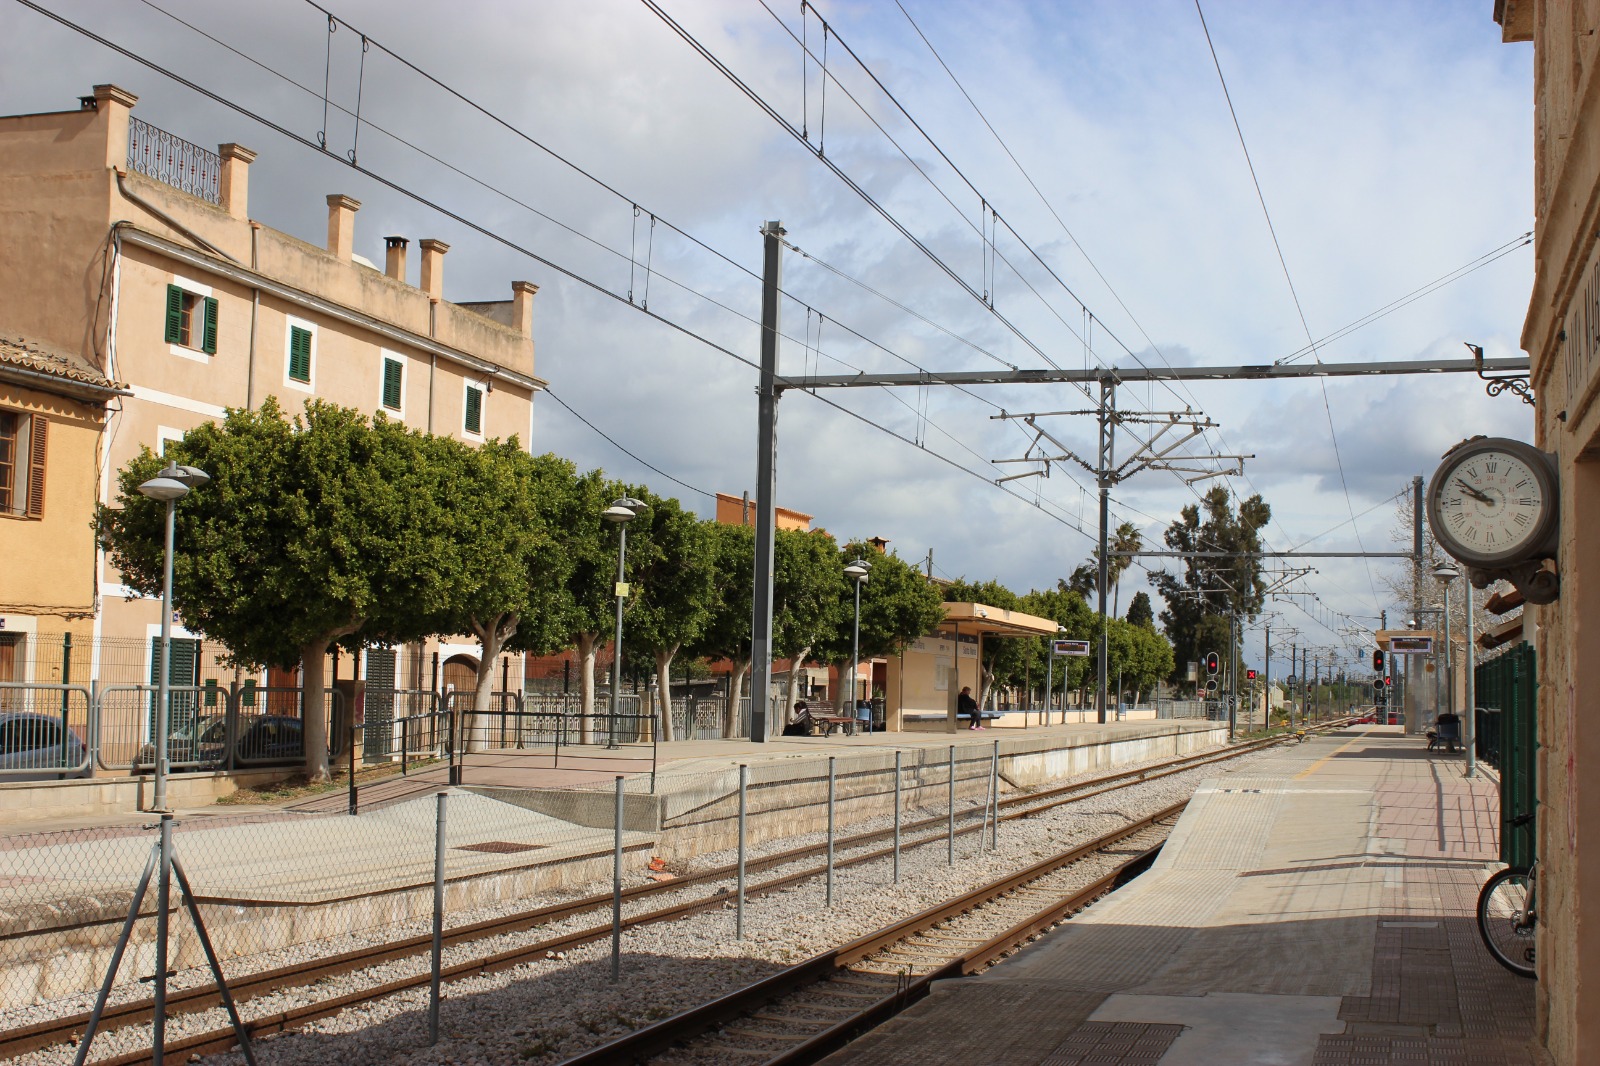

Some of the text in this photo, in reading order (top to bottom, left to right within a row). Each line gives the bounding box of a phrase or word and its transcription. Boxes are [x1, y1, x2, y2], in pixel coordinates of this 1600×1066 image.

[1467, 467, 1477, 478] XI
[1485, 462, 1497, 474] XII
[1505, 466, 1512, 477] I
[1515, 479, 1527, 489] II
[1450, 497, 1461, 506] IX
[1519, 497, 1531, 506] III
[1452, 512, 1466, 528] VIII
[1513, 512, 1529, 527] IIII
[1464, 526, 1477, 540] VII
[1486, 531, 1495, 543] VI
[1504, 528, 1512, 538] V
[1229, 696, 1234, 706] S
